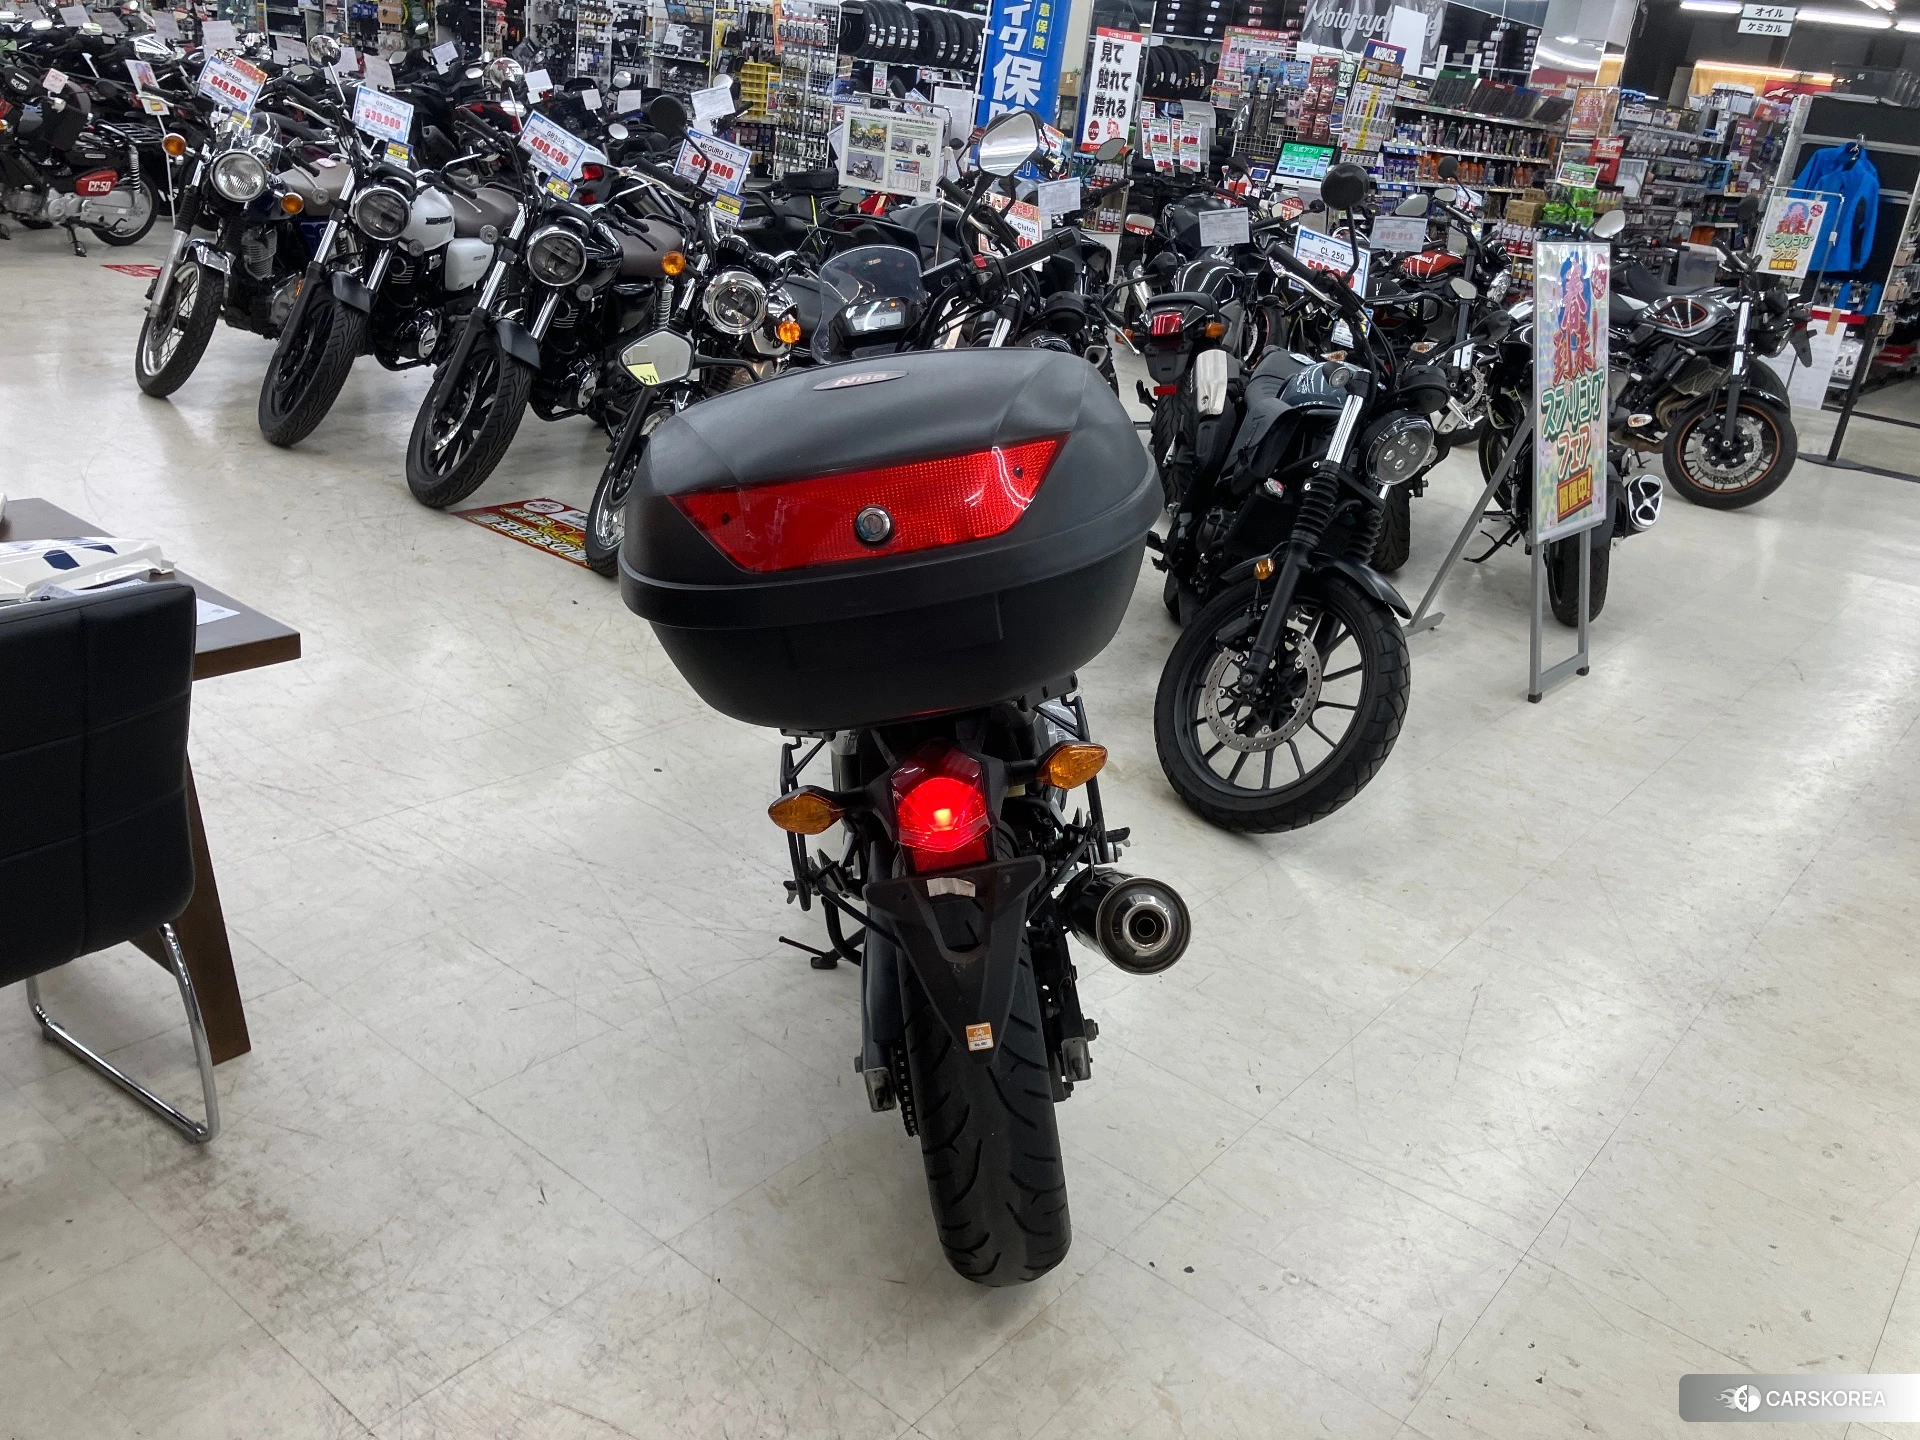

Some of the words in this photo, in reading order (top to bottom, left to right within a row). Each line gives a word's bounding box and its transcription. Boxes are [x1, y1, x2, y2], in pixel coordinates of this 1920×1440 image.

[1755, 7, 1784, 18] オイル
[1747, 22, 1783, 33] ケミカル
[1100, 41, 1124, 64] 見て
[1097, 68, 1132, 92] 触れて
[1293, 145, 1319, 154] 公式アプリ
[88, 181, 112, 192] CC50
[1320, 246, 1330, 256] CL
[1331, 250, 1345, 262] 250
[1557, 422, 1592, 481] フェア
